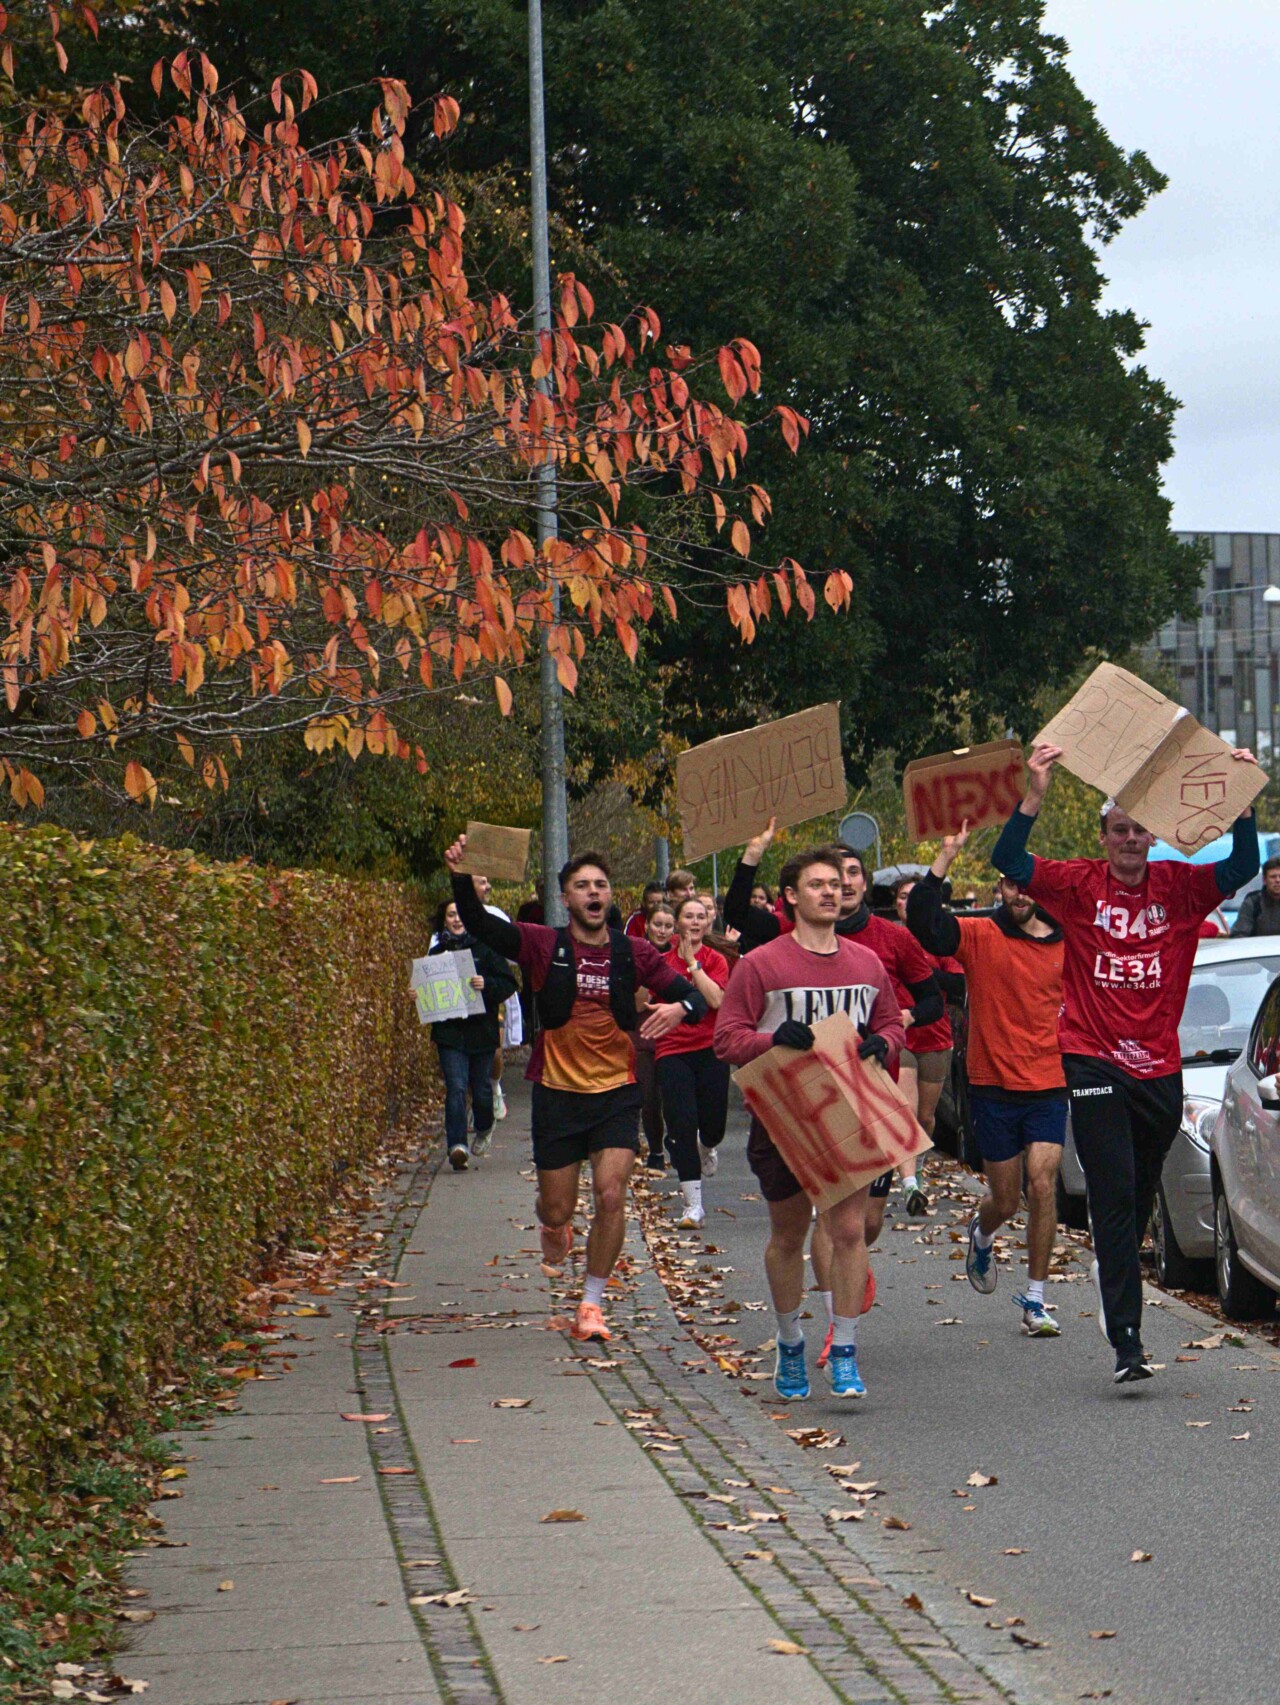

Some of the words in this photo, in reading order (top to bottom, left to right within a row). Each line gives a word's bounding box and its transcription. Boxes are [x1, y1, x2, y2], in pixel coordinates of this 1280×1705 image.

[738, 726, 834, 814] BEVAR
[1175, 751, 1228, 846] NEXS
[1093, 954, 1162, 982] LE34
[416, 975, 477, 1013] NEXS
[1094, 979, 1161, 991] www.le34.dk
[1072, 1085, 1113, 1098] TRAMPEDACH
